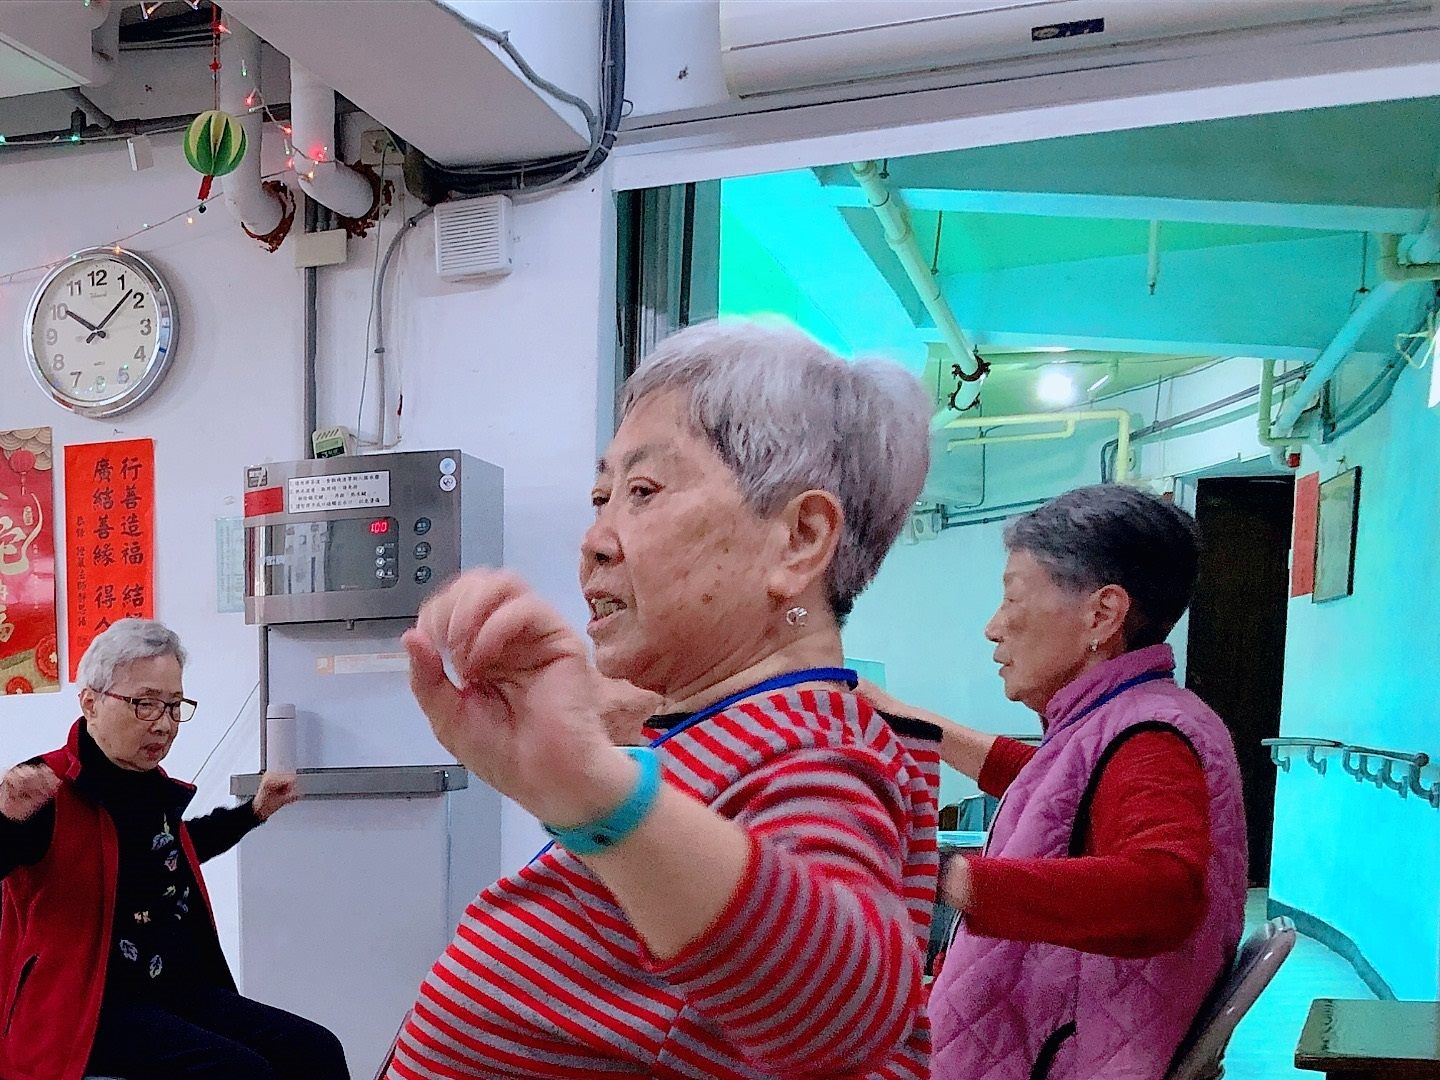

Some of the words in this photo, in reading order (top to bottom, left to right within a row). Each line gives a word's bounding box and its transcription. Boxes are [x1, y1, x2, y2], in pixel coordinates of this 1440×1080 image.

[88, 269, 107, 286] 12
[118, 274, 125, 290] 1
[67, 280, 82, 296] 11
[133, 292, 145, 309] 2
[50, 302, 68, 320] 10
[140, 319, 152, 336] 3
[46, 328, 58, 345] 9
[53, 354, 64, 371] 8
[134, 346, 146, 362] 4
[70, 371, 82, 388] 7
[117, 364, 129, 384] 5
[93, 458, 116, 567] 廣結善緣
[120, 457, 144, 565] 行善造福
[371, 522, 388, 533] 100
